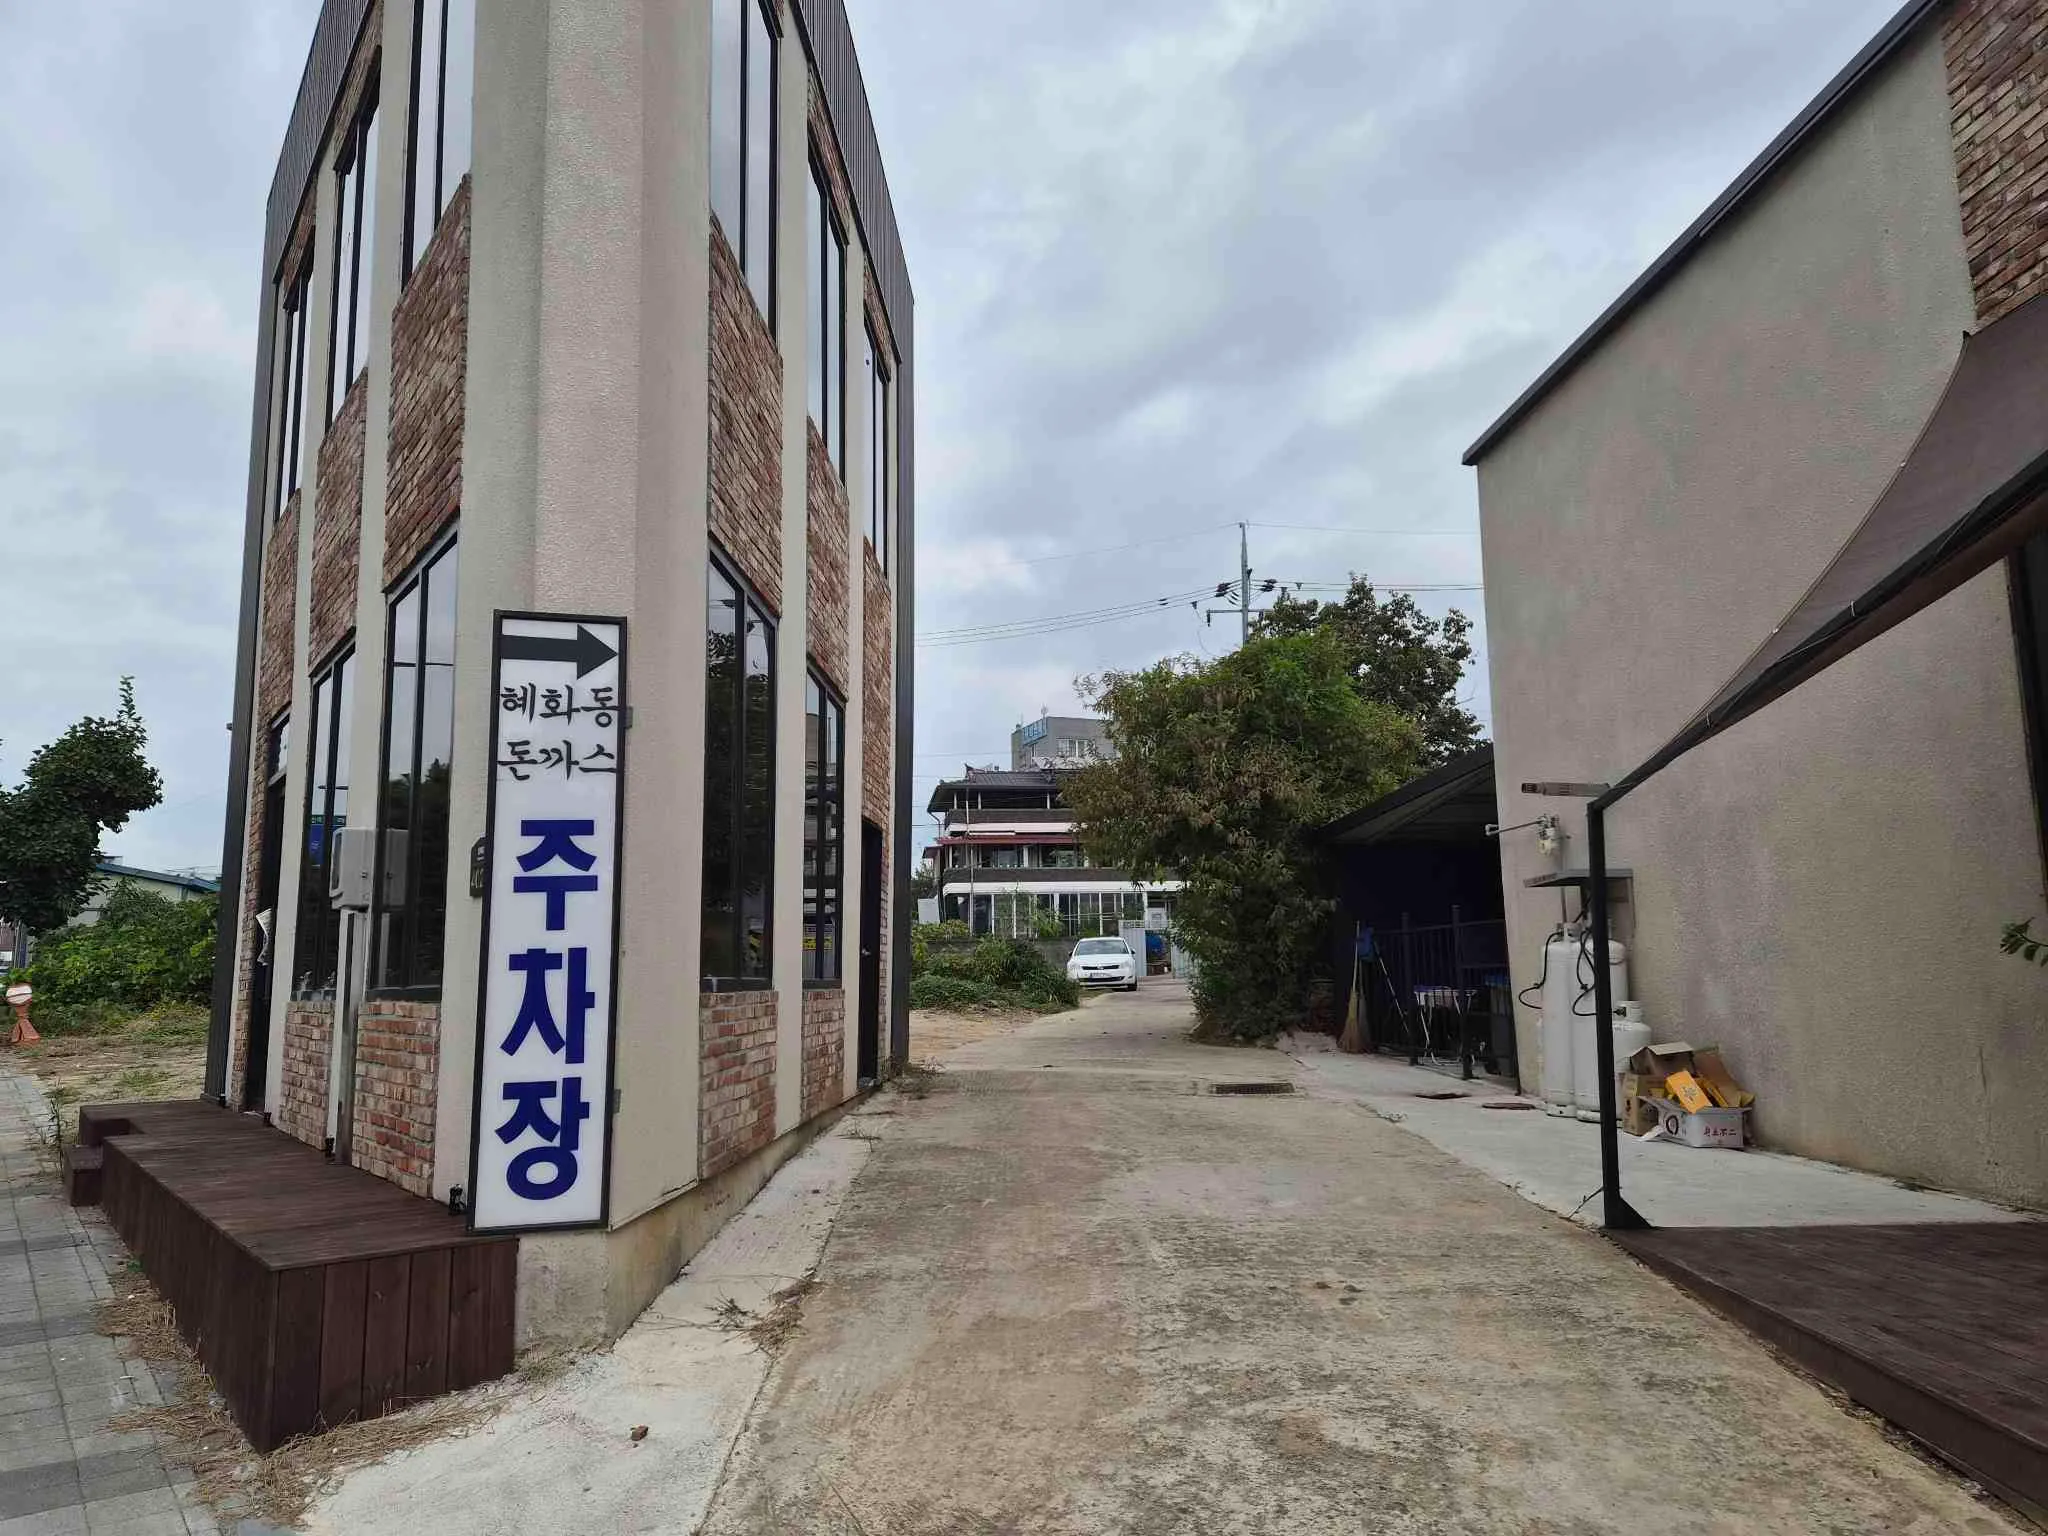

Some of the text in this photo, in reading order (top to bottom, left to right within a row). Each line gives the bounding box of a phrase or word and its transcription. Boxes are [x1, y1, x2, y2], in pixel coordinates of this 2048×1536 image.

[501, 682, 619, 728] 혜화동
[498, 740, 617, 781] 돈까스
[495, 820, 598, 1200] 주차장
